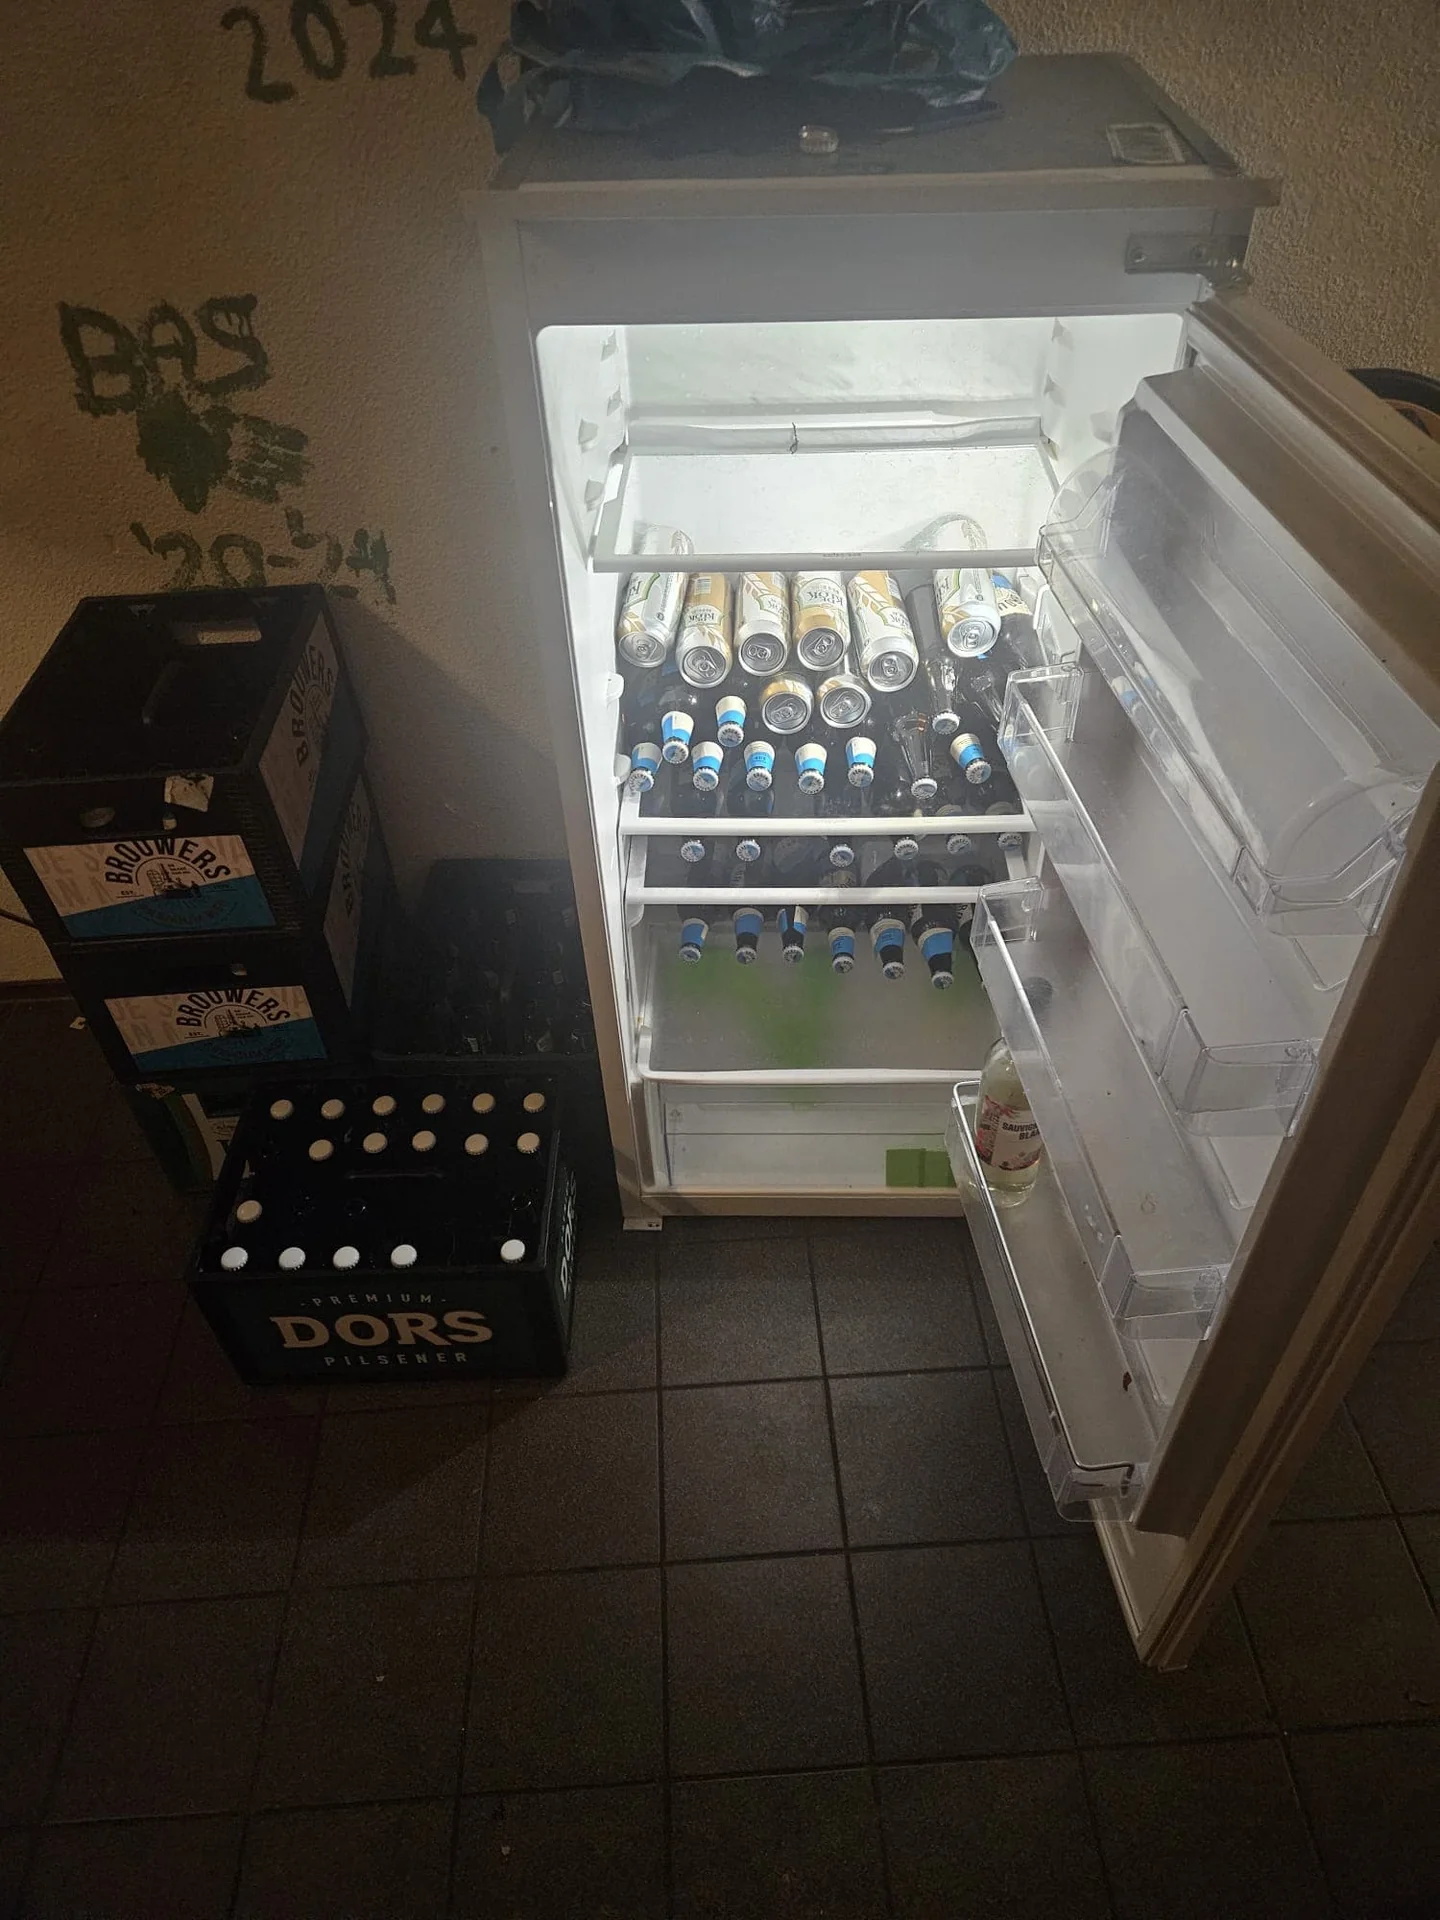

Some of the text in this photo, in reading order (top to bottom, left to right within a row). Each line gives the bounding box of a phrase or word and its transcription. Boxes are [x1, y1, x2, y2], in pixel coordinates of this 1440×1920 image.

[221, 0, 477, 102] 2024
[60, 293, 269, 416] BAS
[106, 837, 231, 885] BROUWERS
[176, 987, 291, 1027] BROUWERS
[1002, 1122, 1038, 1132] SAUVIGN
[269, 1310, 493, 1349] DORS
[324, 1351, 468, 1366] PILSENER
